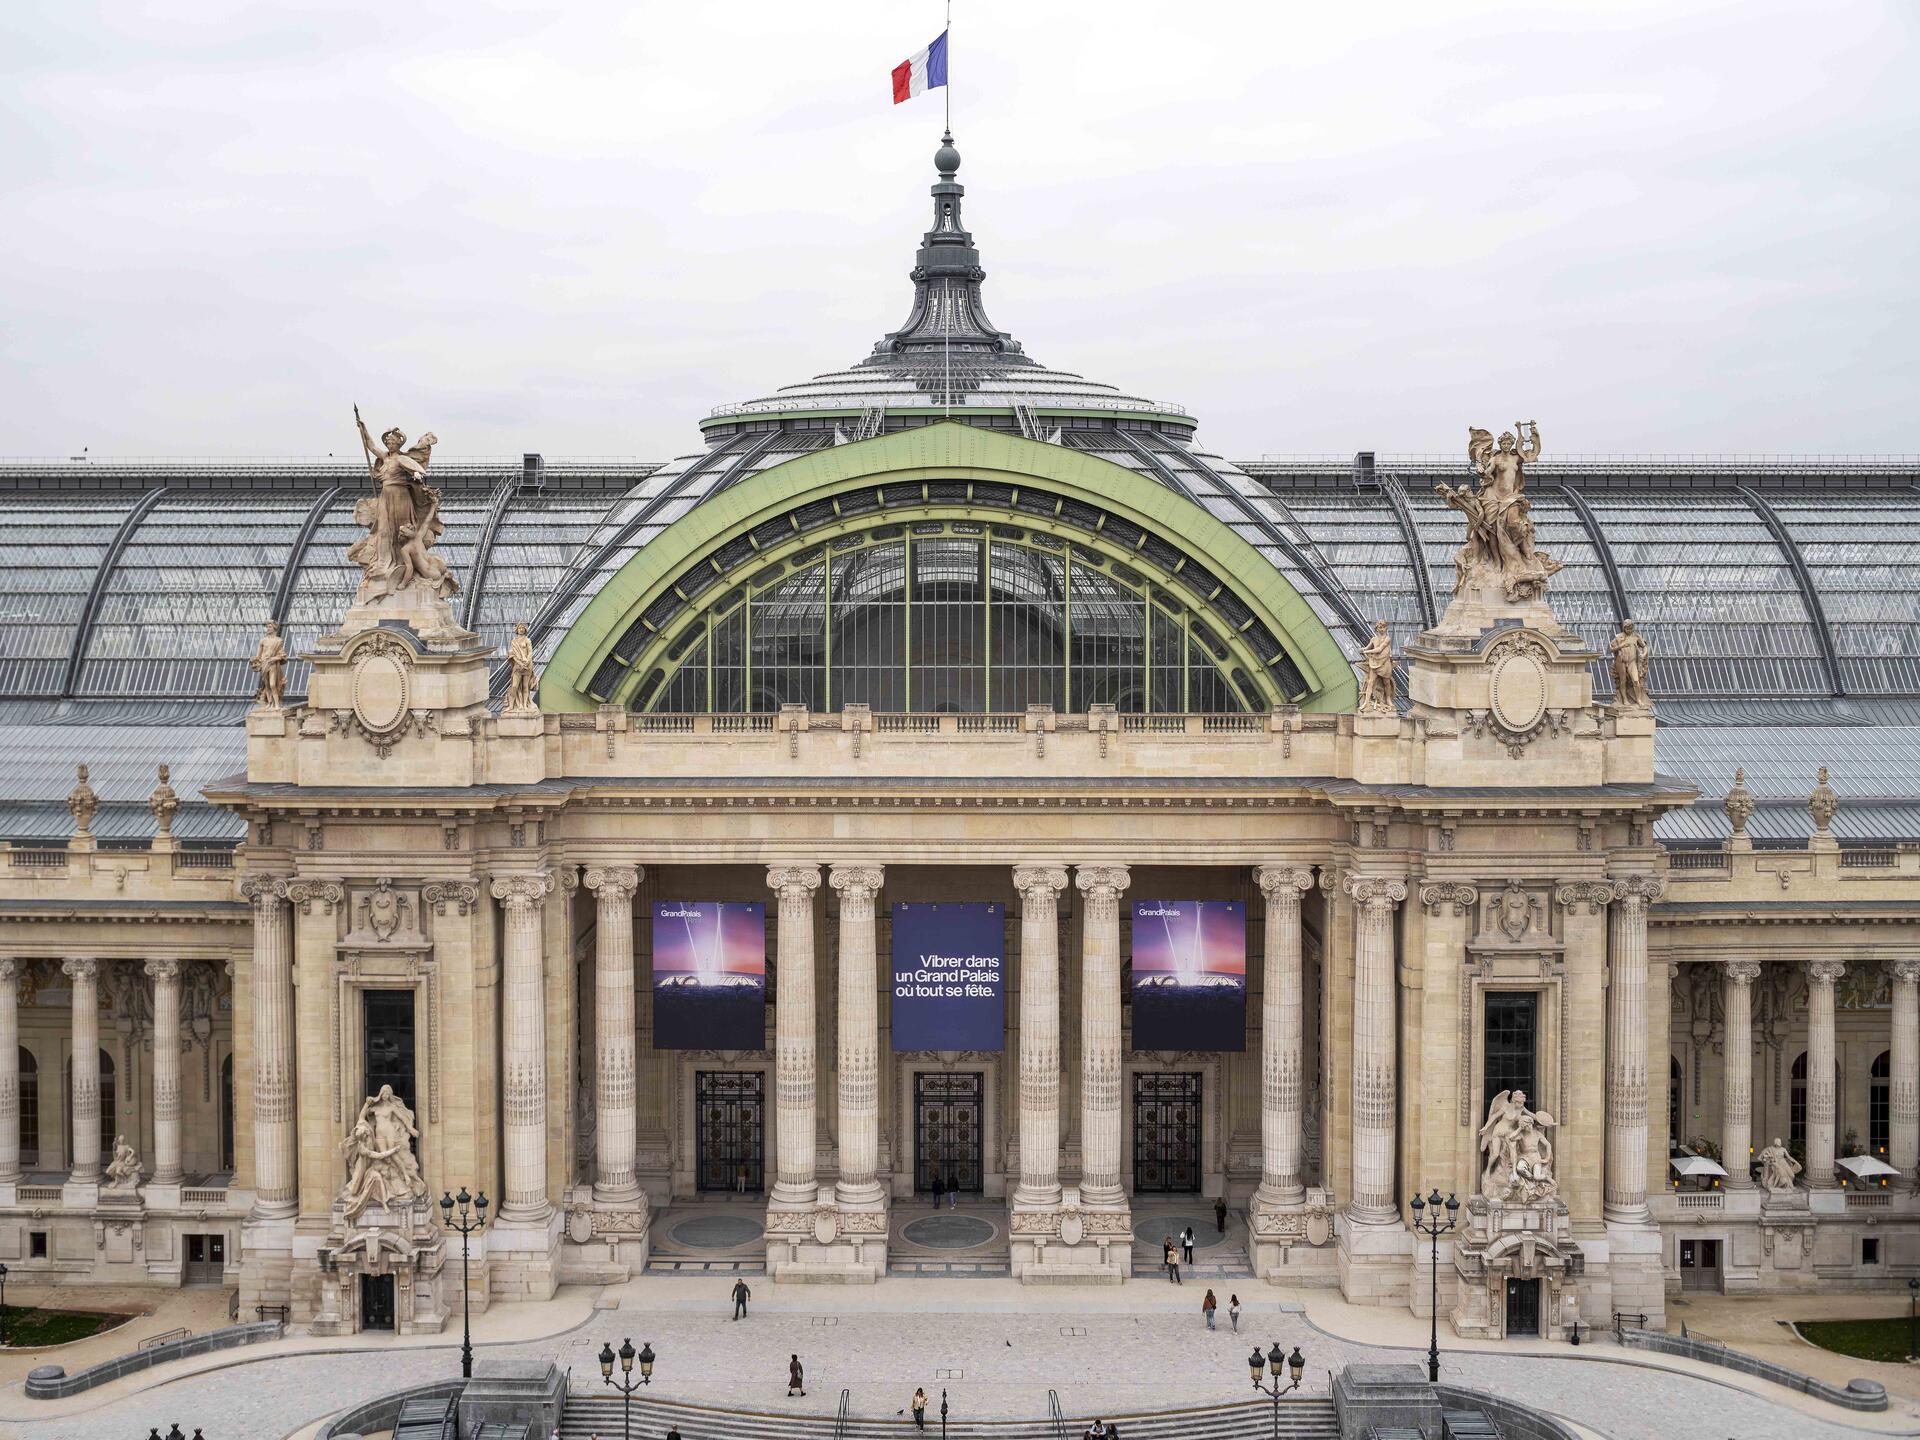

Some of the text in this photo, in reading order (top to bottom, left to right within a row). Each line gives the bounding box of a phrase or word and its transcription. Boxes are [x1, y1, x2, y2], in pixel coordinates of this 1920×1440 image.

[920, 955, 1000, 968] Vibrer dans
[895, 970, 1000, 982] un Grand Palais
[895, 984, 995, 997] où tout se fête.
